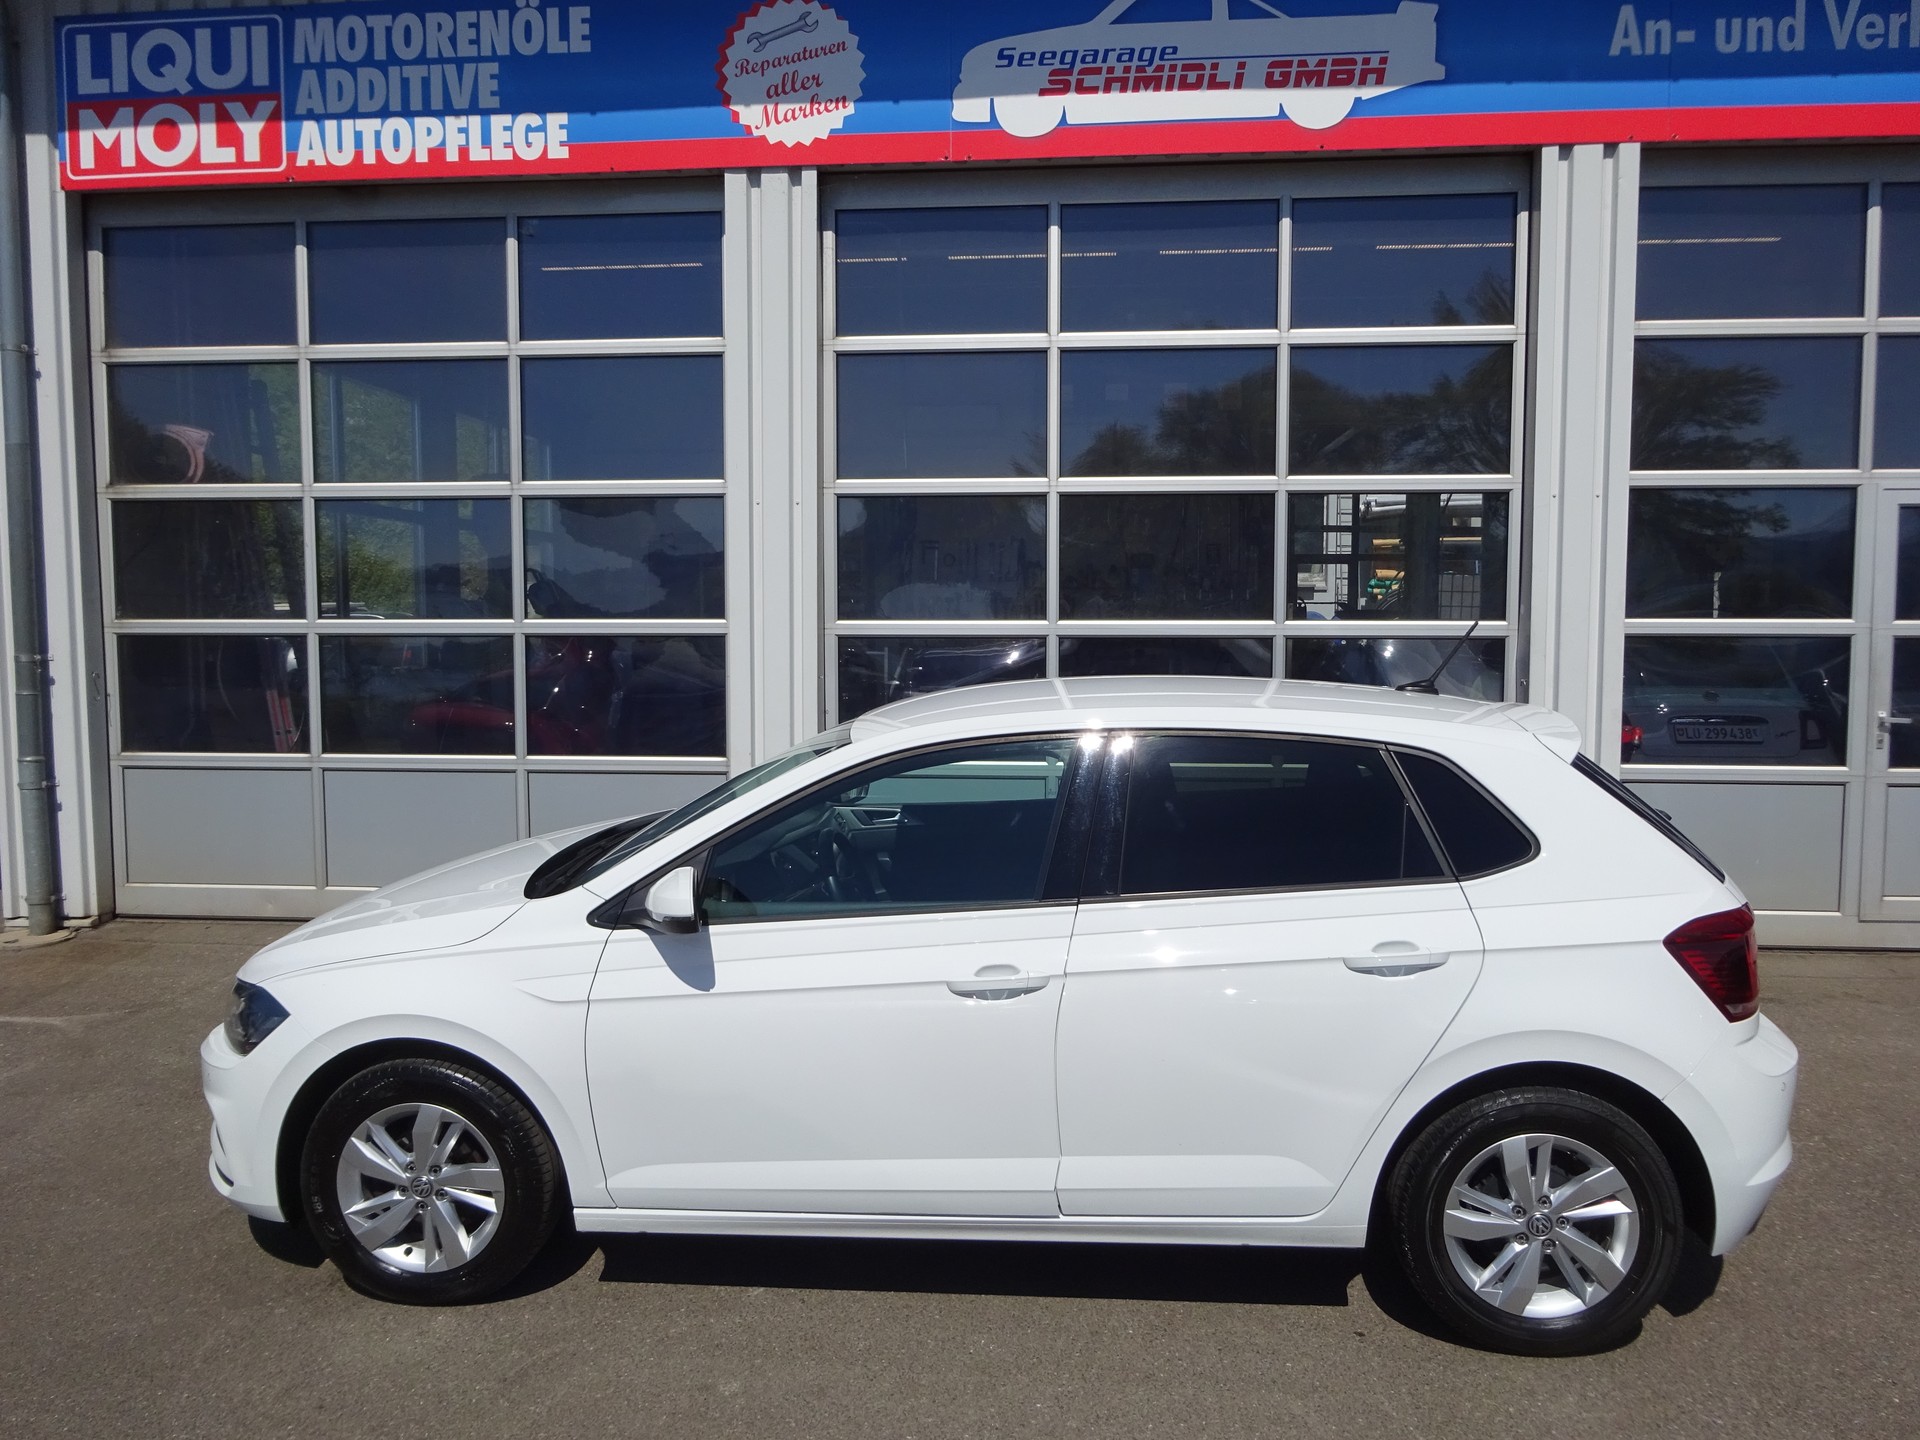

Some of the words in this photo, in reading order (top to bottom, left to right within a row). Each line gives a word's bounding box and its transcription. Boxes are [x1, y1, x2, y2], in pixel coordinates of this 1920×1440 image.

[293, 0, 592, 63] MOTORENÖLE
[1609, 4, 1696, 56] An-
[1715, 0, 1806, 54] und
[74, 25, 270, 95] LIQUI
[734, 40, 849, 78] Reparaturen
[766, 70, 824, 99] aller
[995, 45, 1179, 70] Seegarage
[1264, 56, 1389, 89] GMBH
[295, 62, 500, 116] ADDITIVE
[754, 92, 850, 130] Marken
[78, 100, 278, 169] MOLY
[295, 112, 569, 166] AUTOPFLEGE
